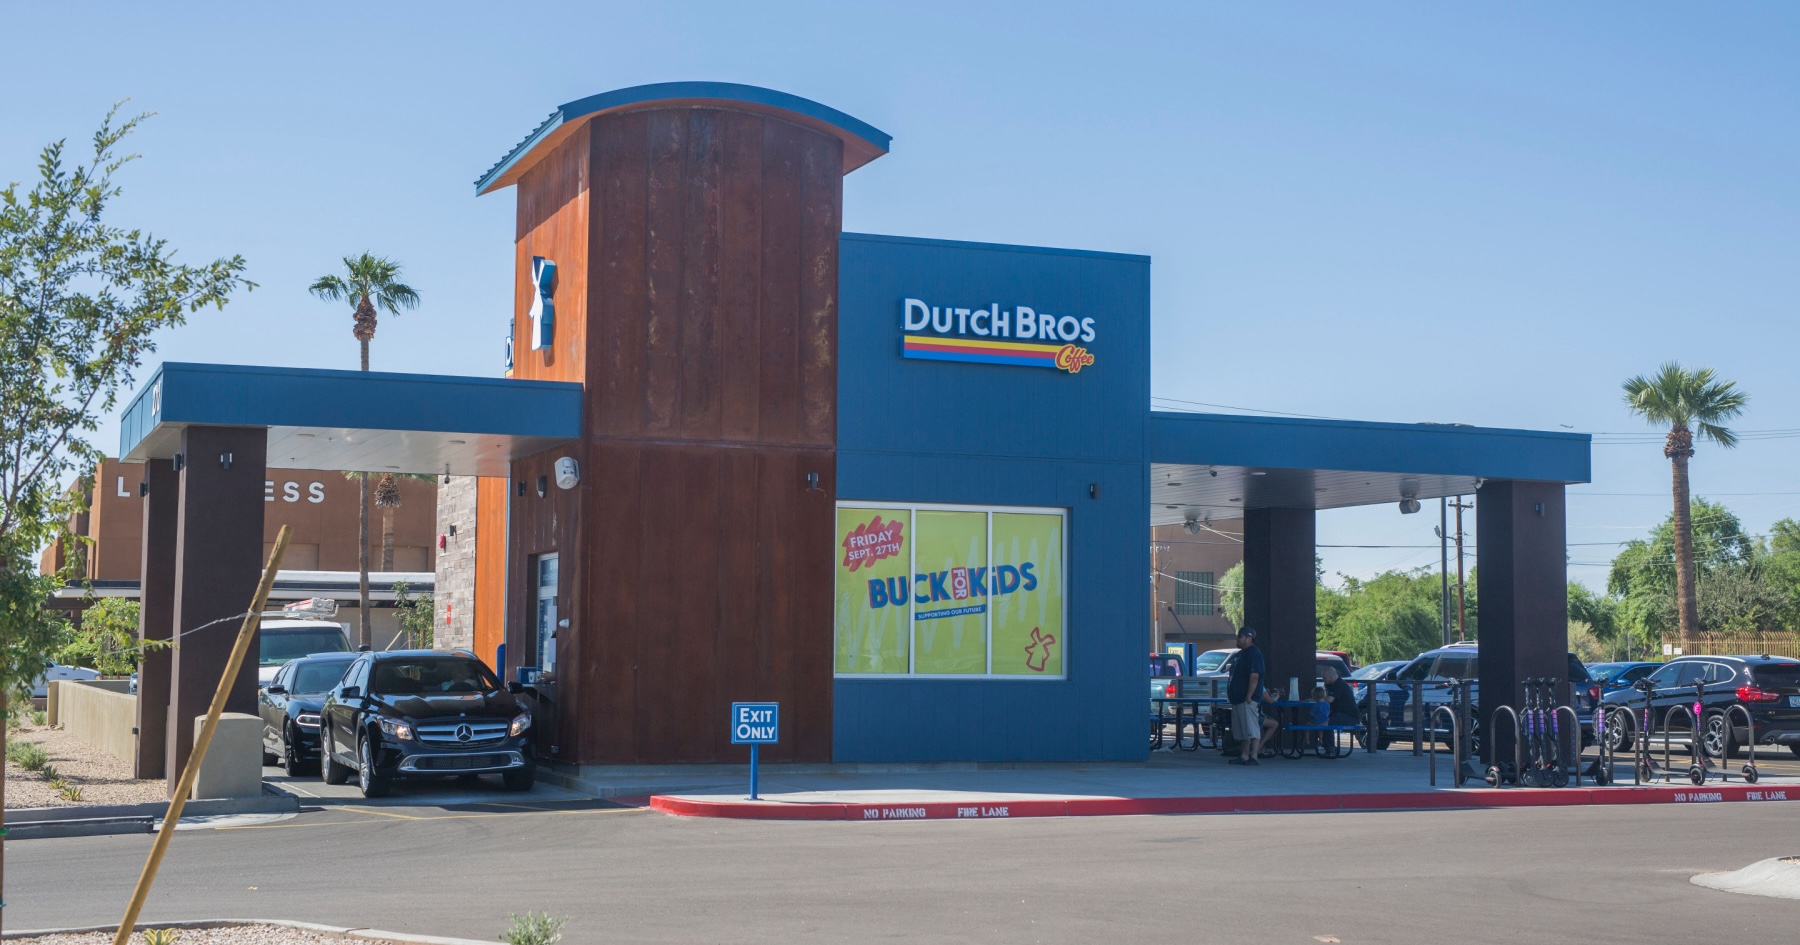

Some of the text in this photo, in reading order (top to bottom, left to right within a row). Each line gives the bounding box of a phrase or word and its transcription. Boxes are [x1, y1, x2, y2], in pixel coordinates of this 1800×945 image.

[904, 298, 1096, 342] DUTCH BROS
[1056, 345, 1094, 372] Coffee
[117, 476, 325, 503] L ESS
[850, 530, 893, 548] FRIDAY
[848, 543, 900, 560] SEPT. 27TH
[868, 570, 952, 609] BUCK
[953, 568, 968, 599] FOR
[918, 610, 950, 619] SUPPORTING
[740, 707, 773, 723] EXIT
[736, 723, 776, 739] ONLY
[1674, 791, 1787, 802] NO PARKING FIRE LANE
[863, 806, 1009, 819] NO PARKING FIRE LANE
